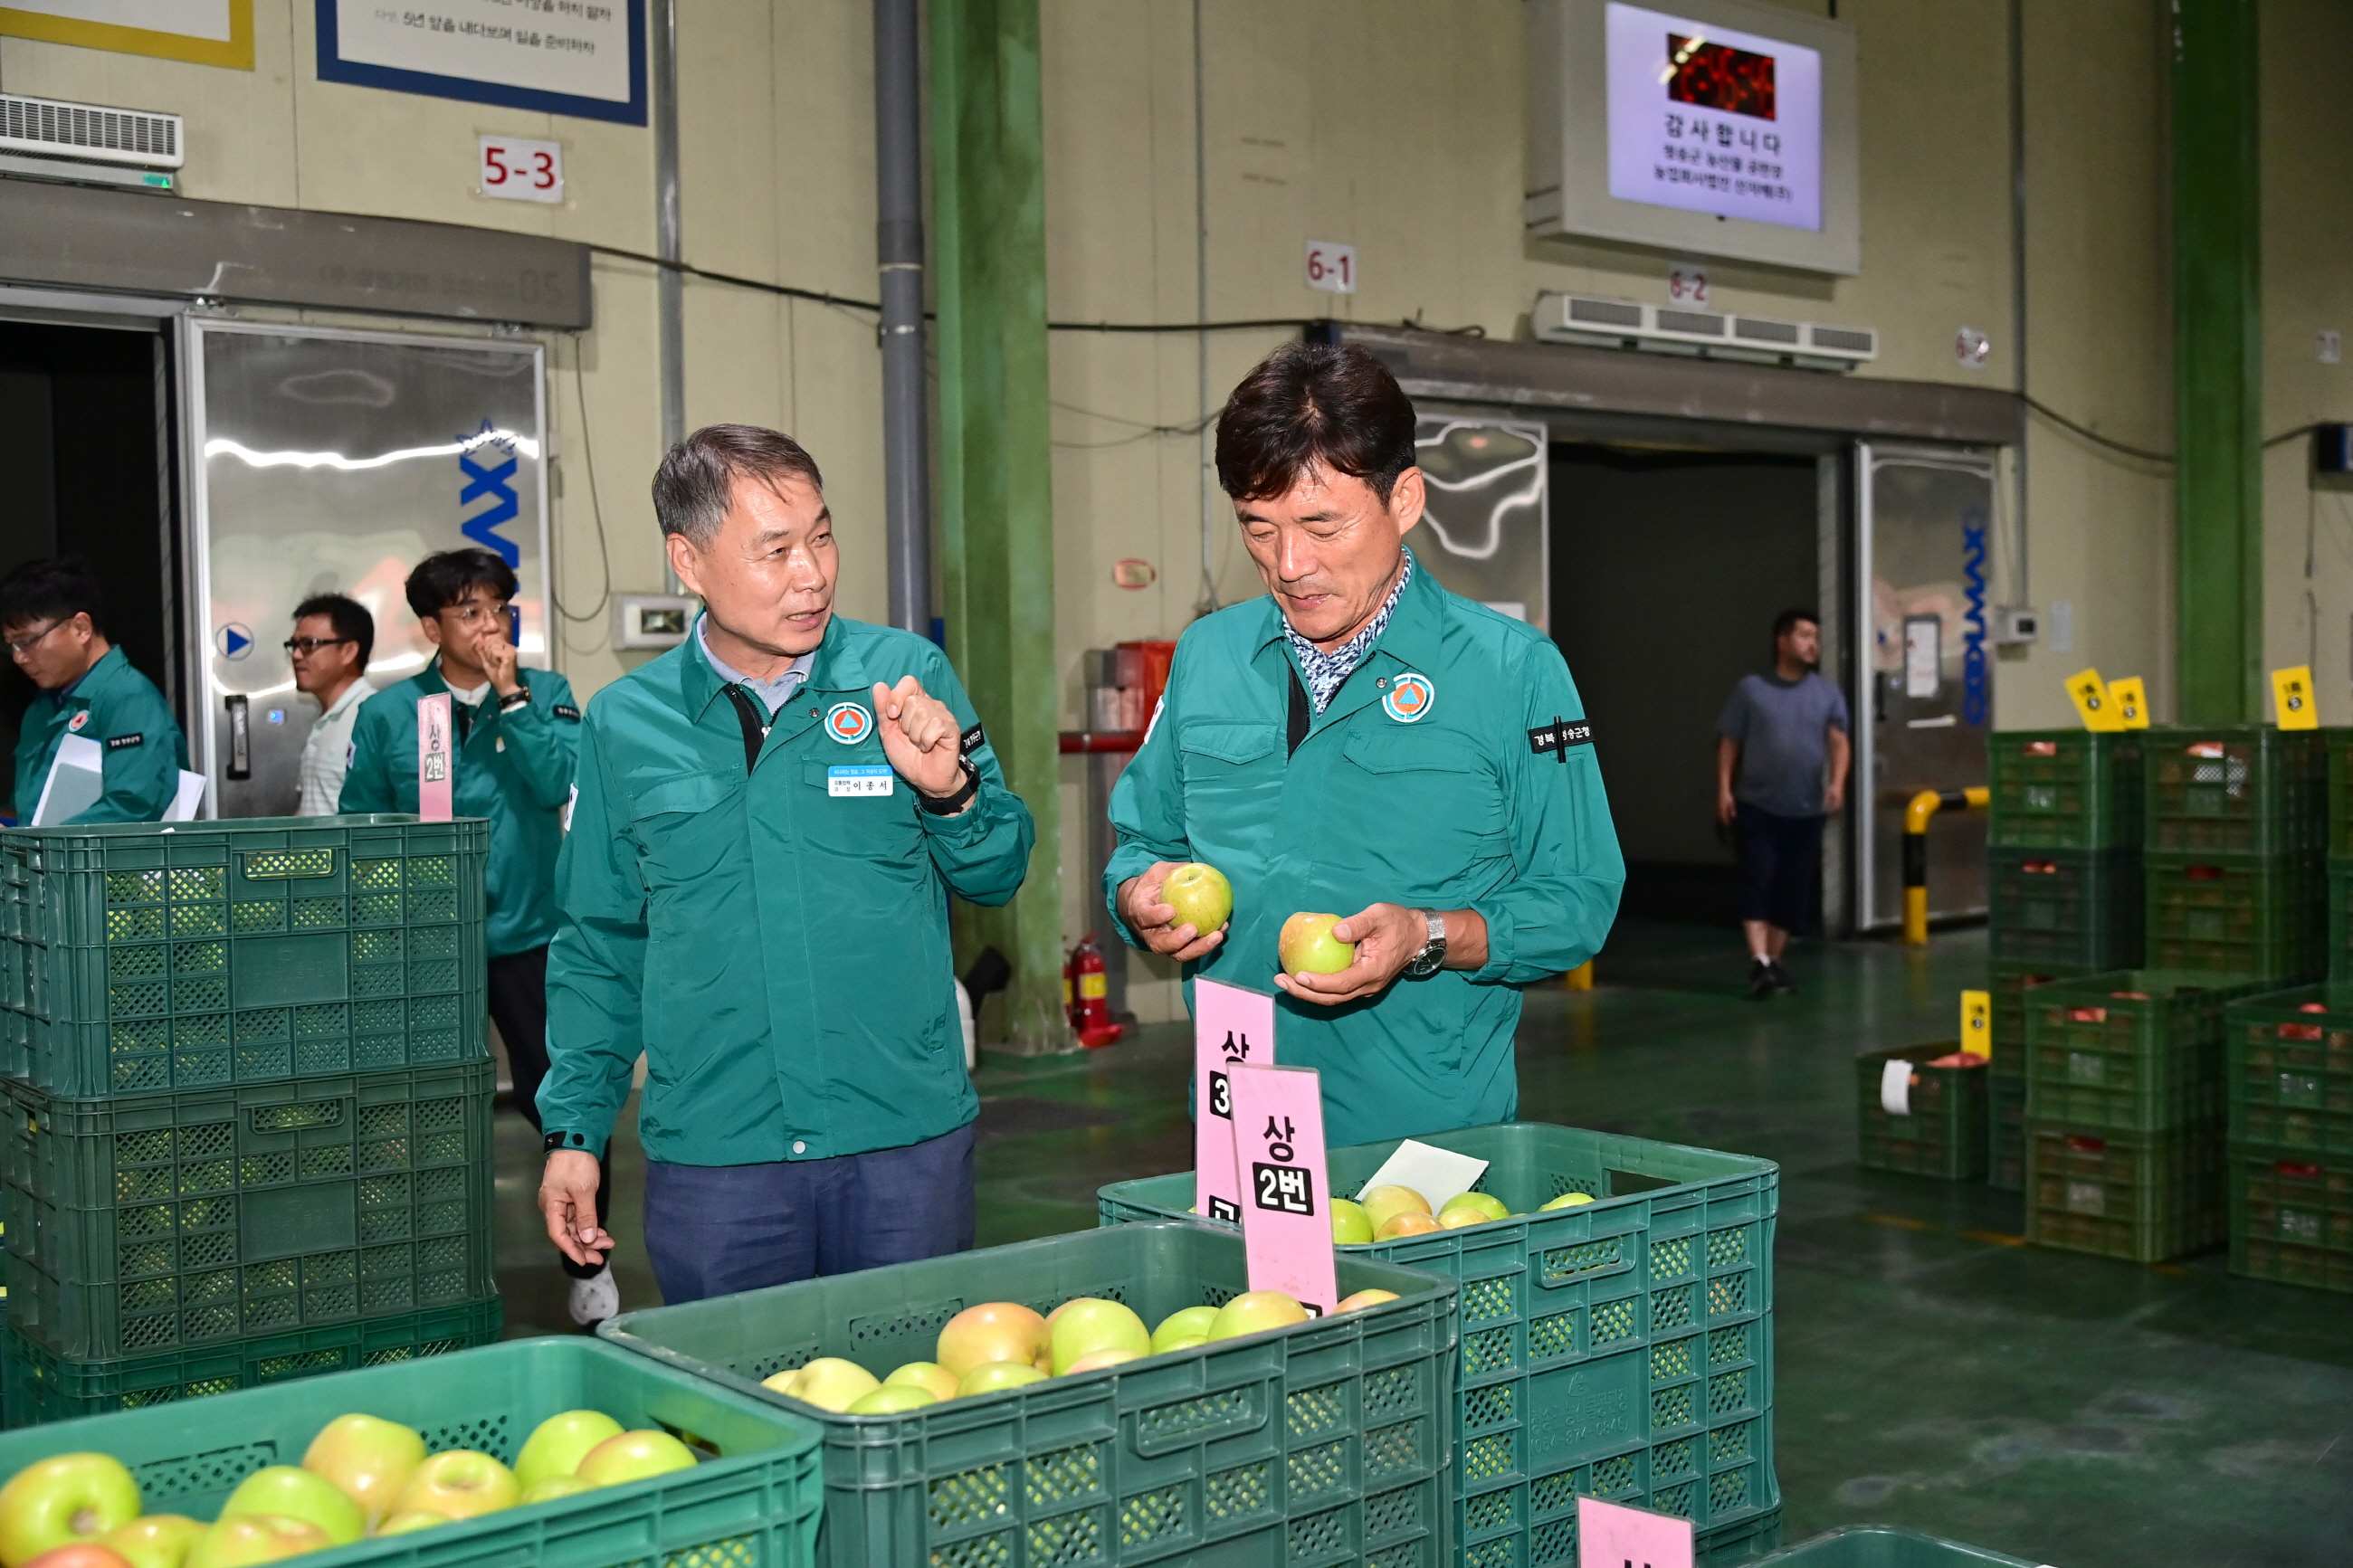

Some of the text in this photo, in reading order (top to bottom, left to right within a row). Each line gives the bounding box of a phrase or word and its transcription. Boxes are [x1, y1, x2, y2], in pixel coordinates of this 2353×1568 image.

[485, 147, 556, 190] 5-3
[1307, 249, 1349, 286] 6-1
[1670, 271, 1706, 301] 6-2
[429, 724, 441, 752] 상
[1534, 732, 1555, 746] 경북
[425, 754, 444, 780] 2번
[1262, 1115, 1295, 1164] 상
[1259, 1167, 1309, 1213] 2번
